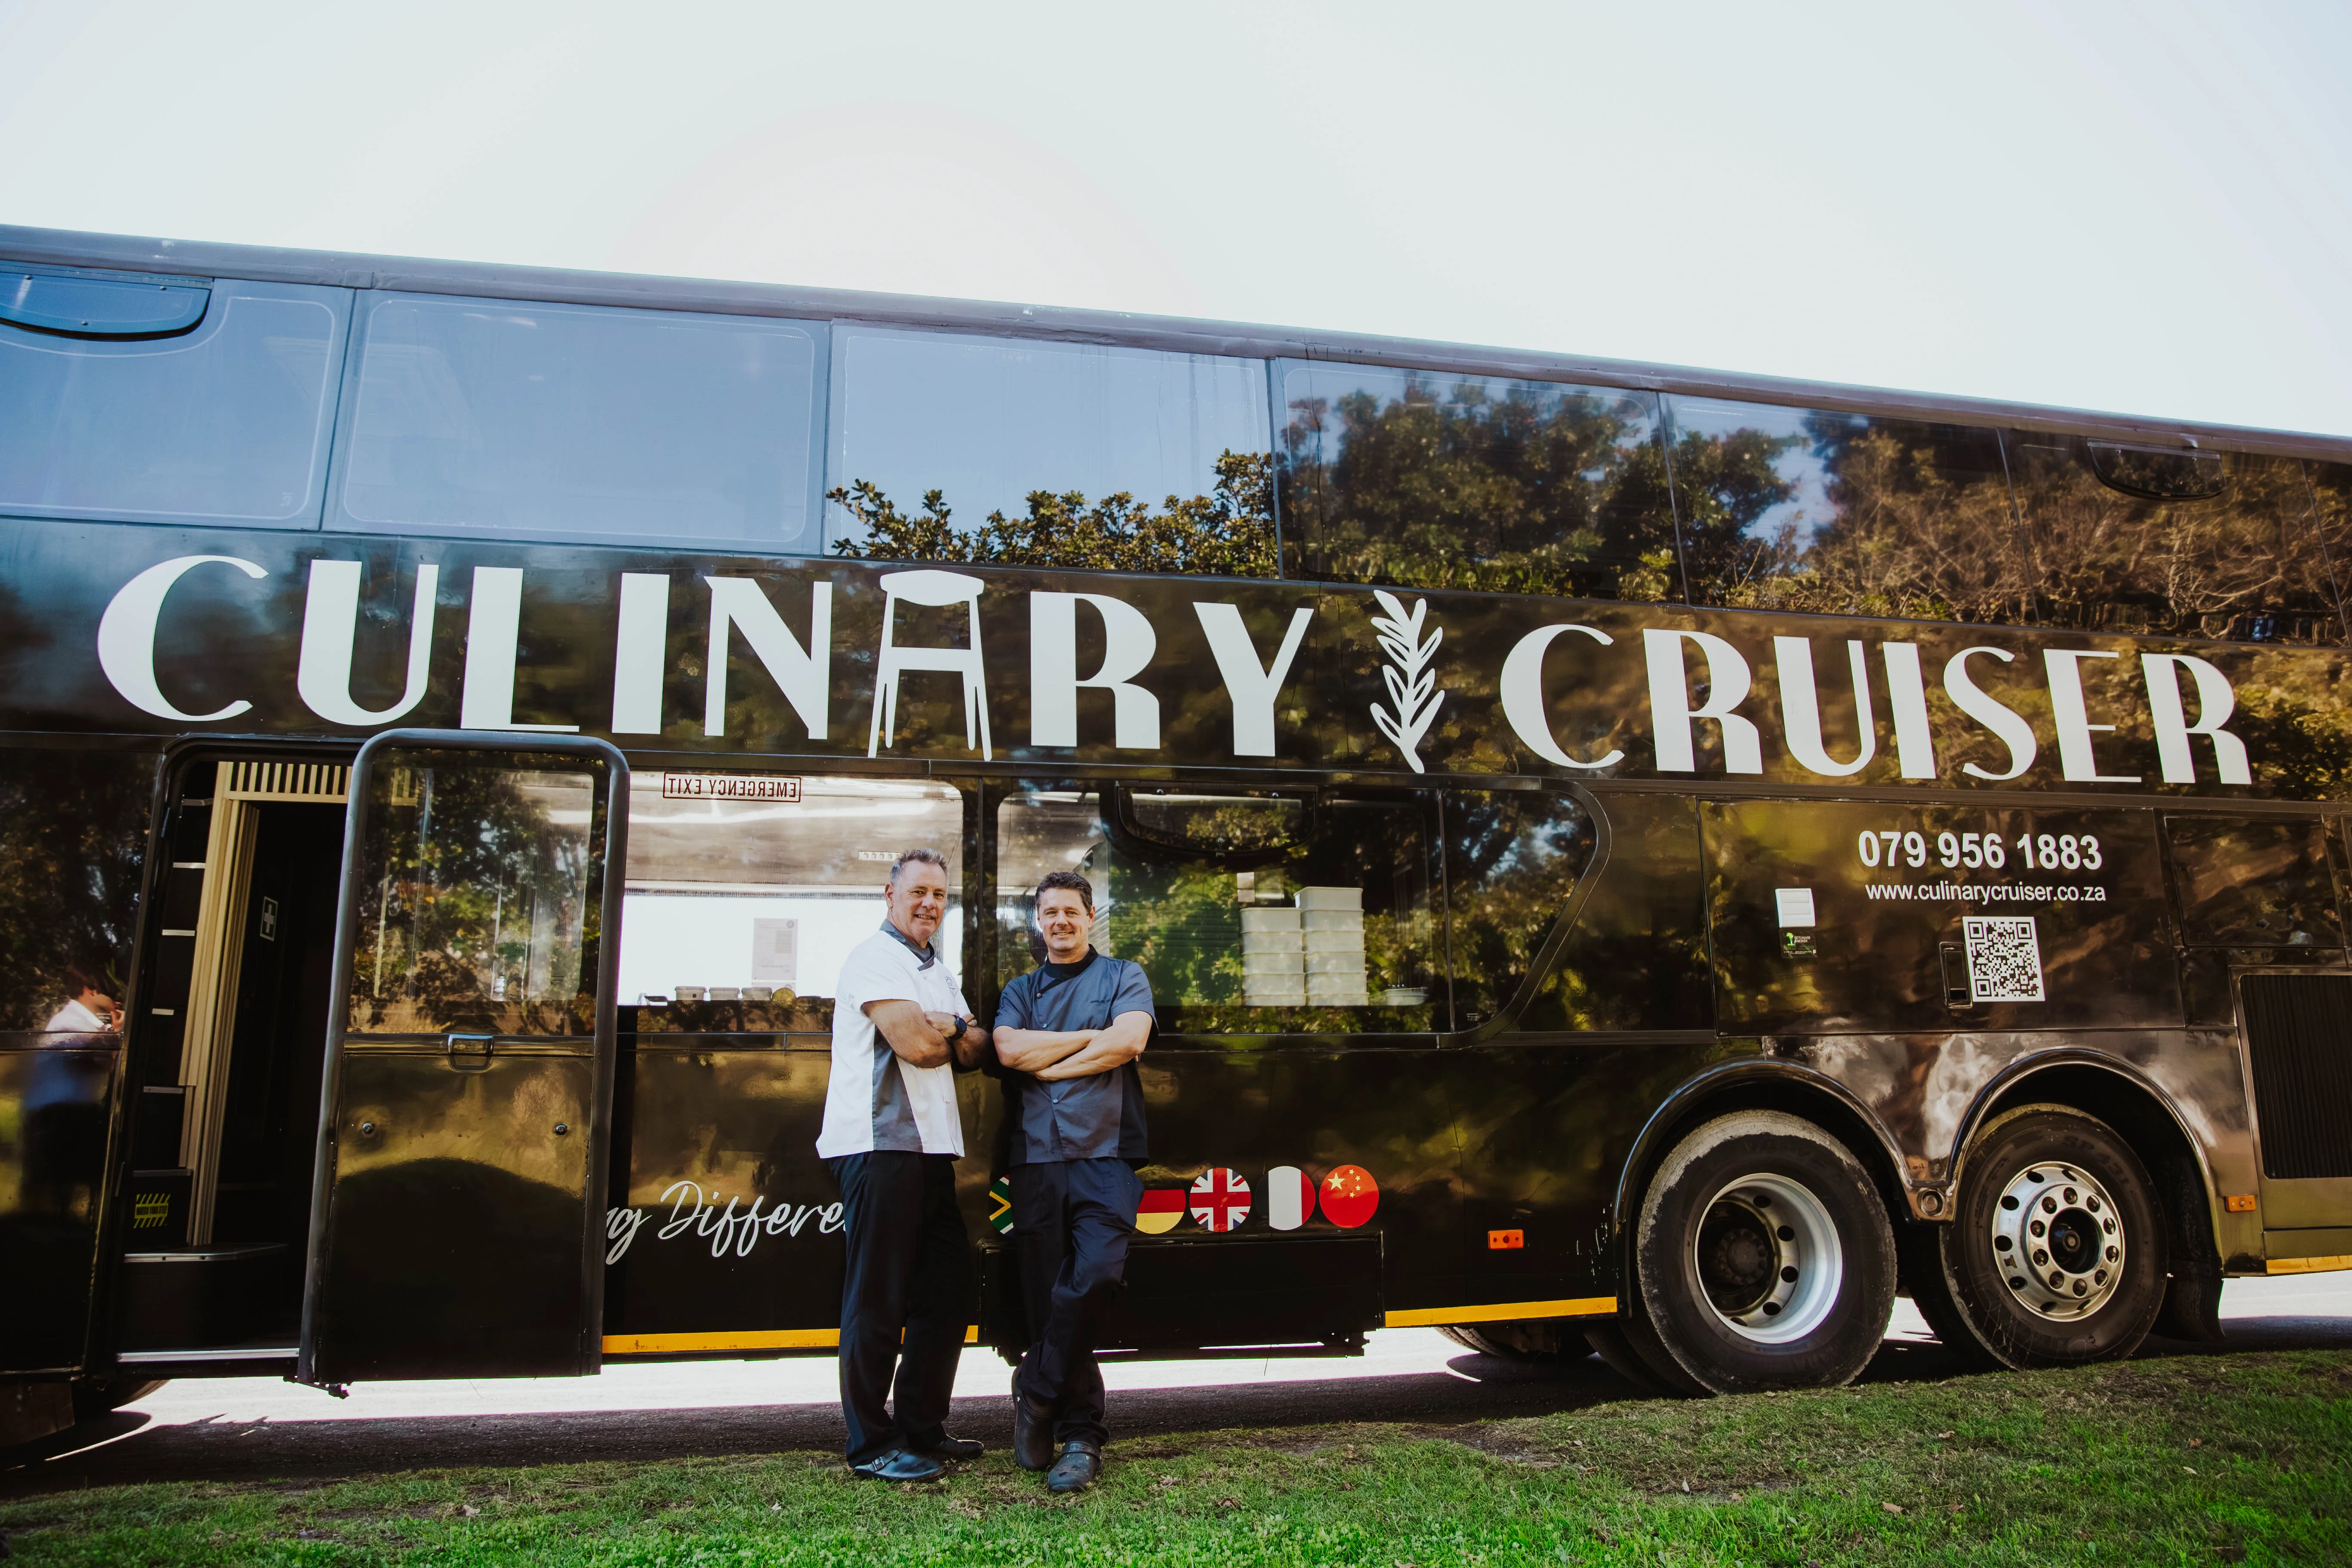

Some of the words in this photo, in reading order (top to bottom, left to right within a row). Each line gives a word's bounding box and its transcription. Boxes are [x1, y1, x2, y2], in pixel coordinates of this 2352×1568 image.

[98, 554, 1314, 762] CULINARY
[1500, 624, 2252, 785] CRUISER
[1858, 830, 1926, 868] 079
[1937, 832, 2005, 869] 956
[2017, 833, 2103, 870] 1883
[1865, 880, 2106, 905] www.culinarycruiser.co.za
[657, 1180, 846, 1258] Differe
